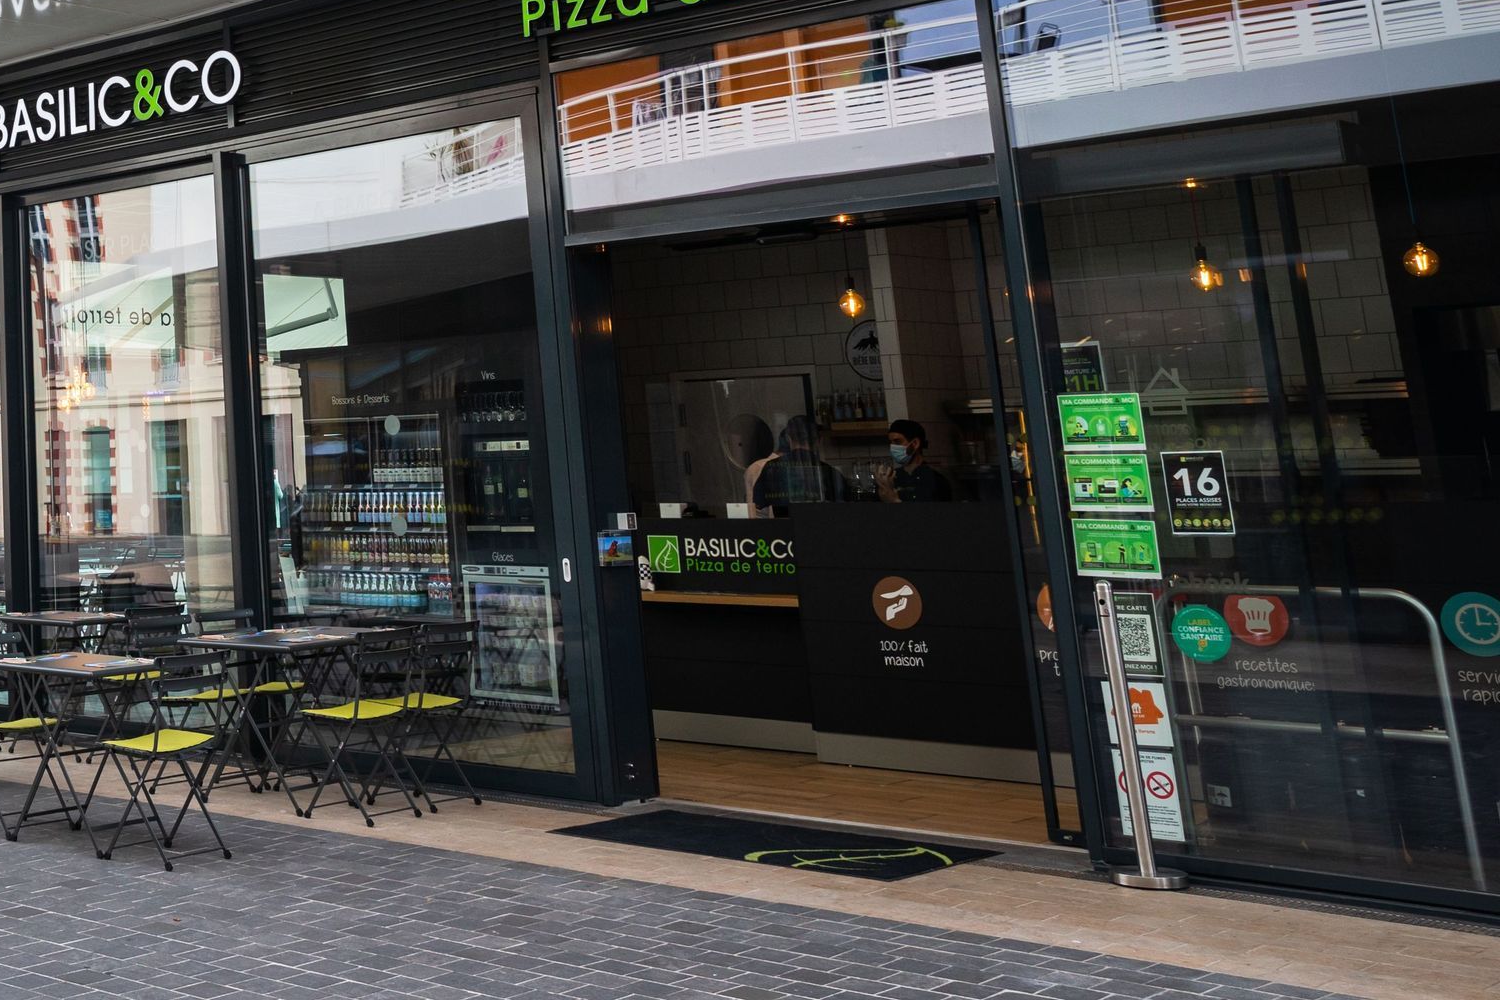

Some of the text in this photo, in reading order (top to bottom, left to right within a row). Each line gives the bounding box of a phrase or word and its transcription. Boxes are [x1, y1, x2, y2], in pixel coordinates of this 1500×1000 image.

[481, 370, 496, 380] Vins
[363, 394, 390, 404] Desserts
[1173, 467, 1220, 497] 16
[492, 552, 514, 563] Glaces
[686, 558, 724, 573] Pizza
[731, 560, 751, 573] de
[1178, 626, 1224, 634] CONFIANCE
[1180, 633, 1223, 641] SANITAIRE
[908, 640, 928, 653] fait
[884, 654, 924, 667] maison
[1235, 658, 1298, 674] recettes
